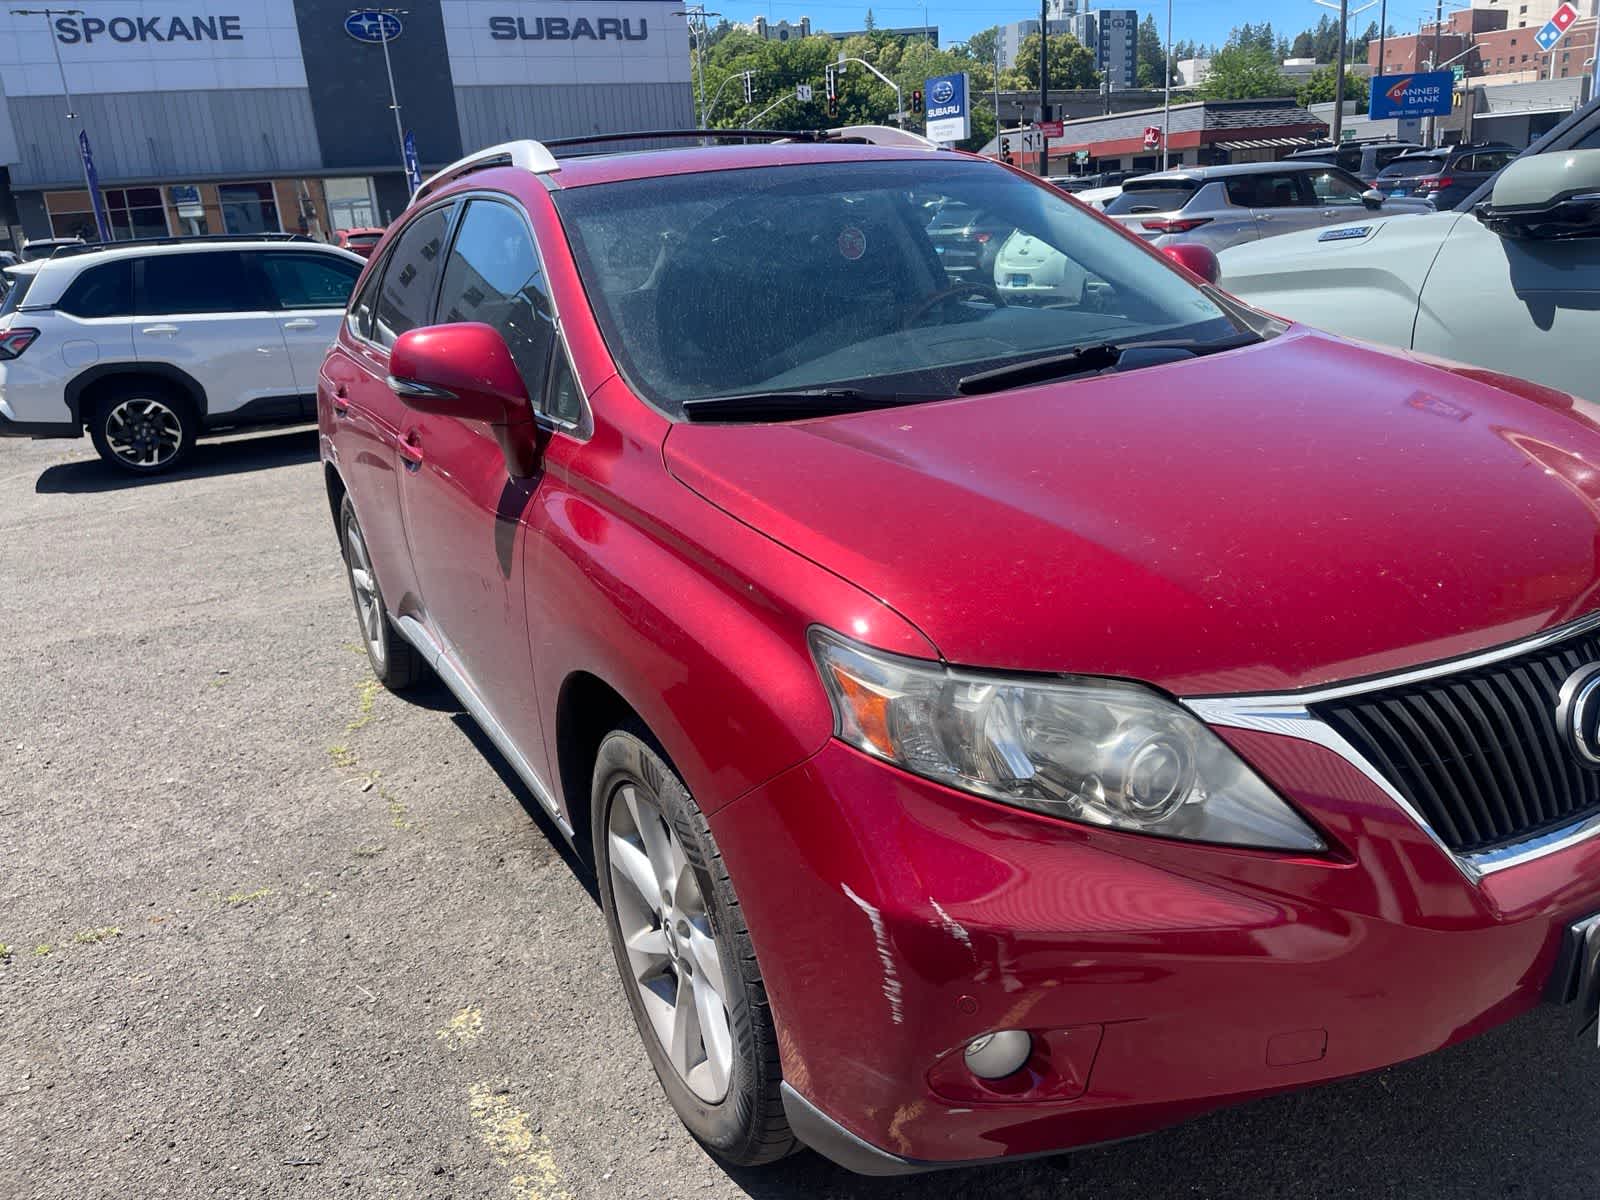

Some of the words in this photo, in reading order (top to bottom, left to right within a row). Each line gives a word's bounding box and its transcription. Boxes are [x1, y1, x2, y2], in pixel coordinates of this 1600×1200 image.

[55, 16, 244, 44] SPOKANE
[489, 16, 648, 41] SUBARU
[1393, 87, 1440, 97] BANNER
[1408, 95, 1440, 104] BANK
[928, 104, 960, 118] SUBARU
